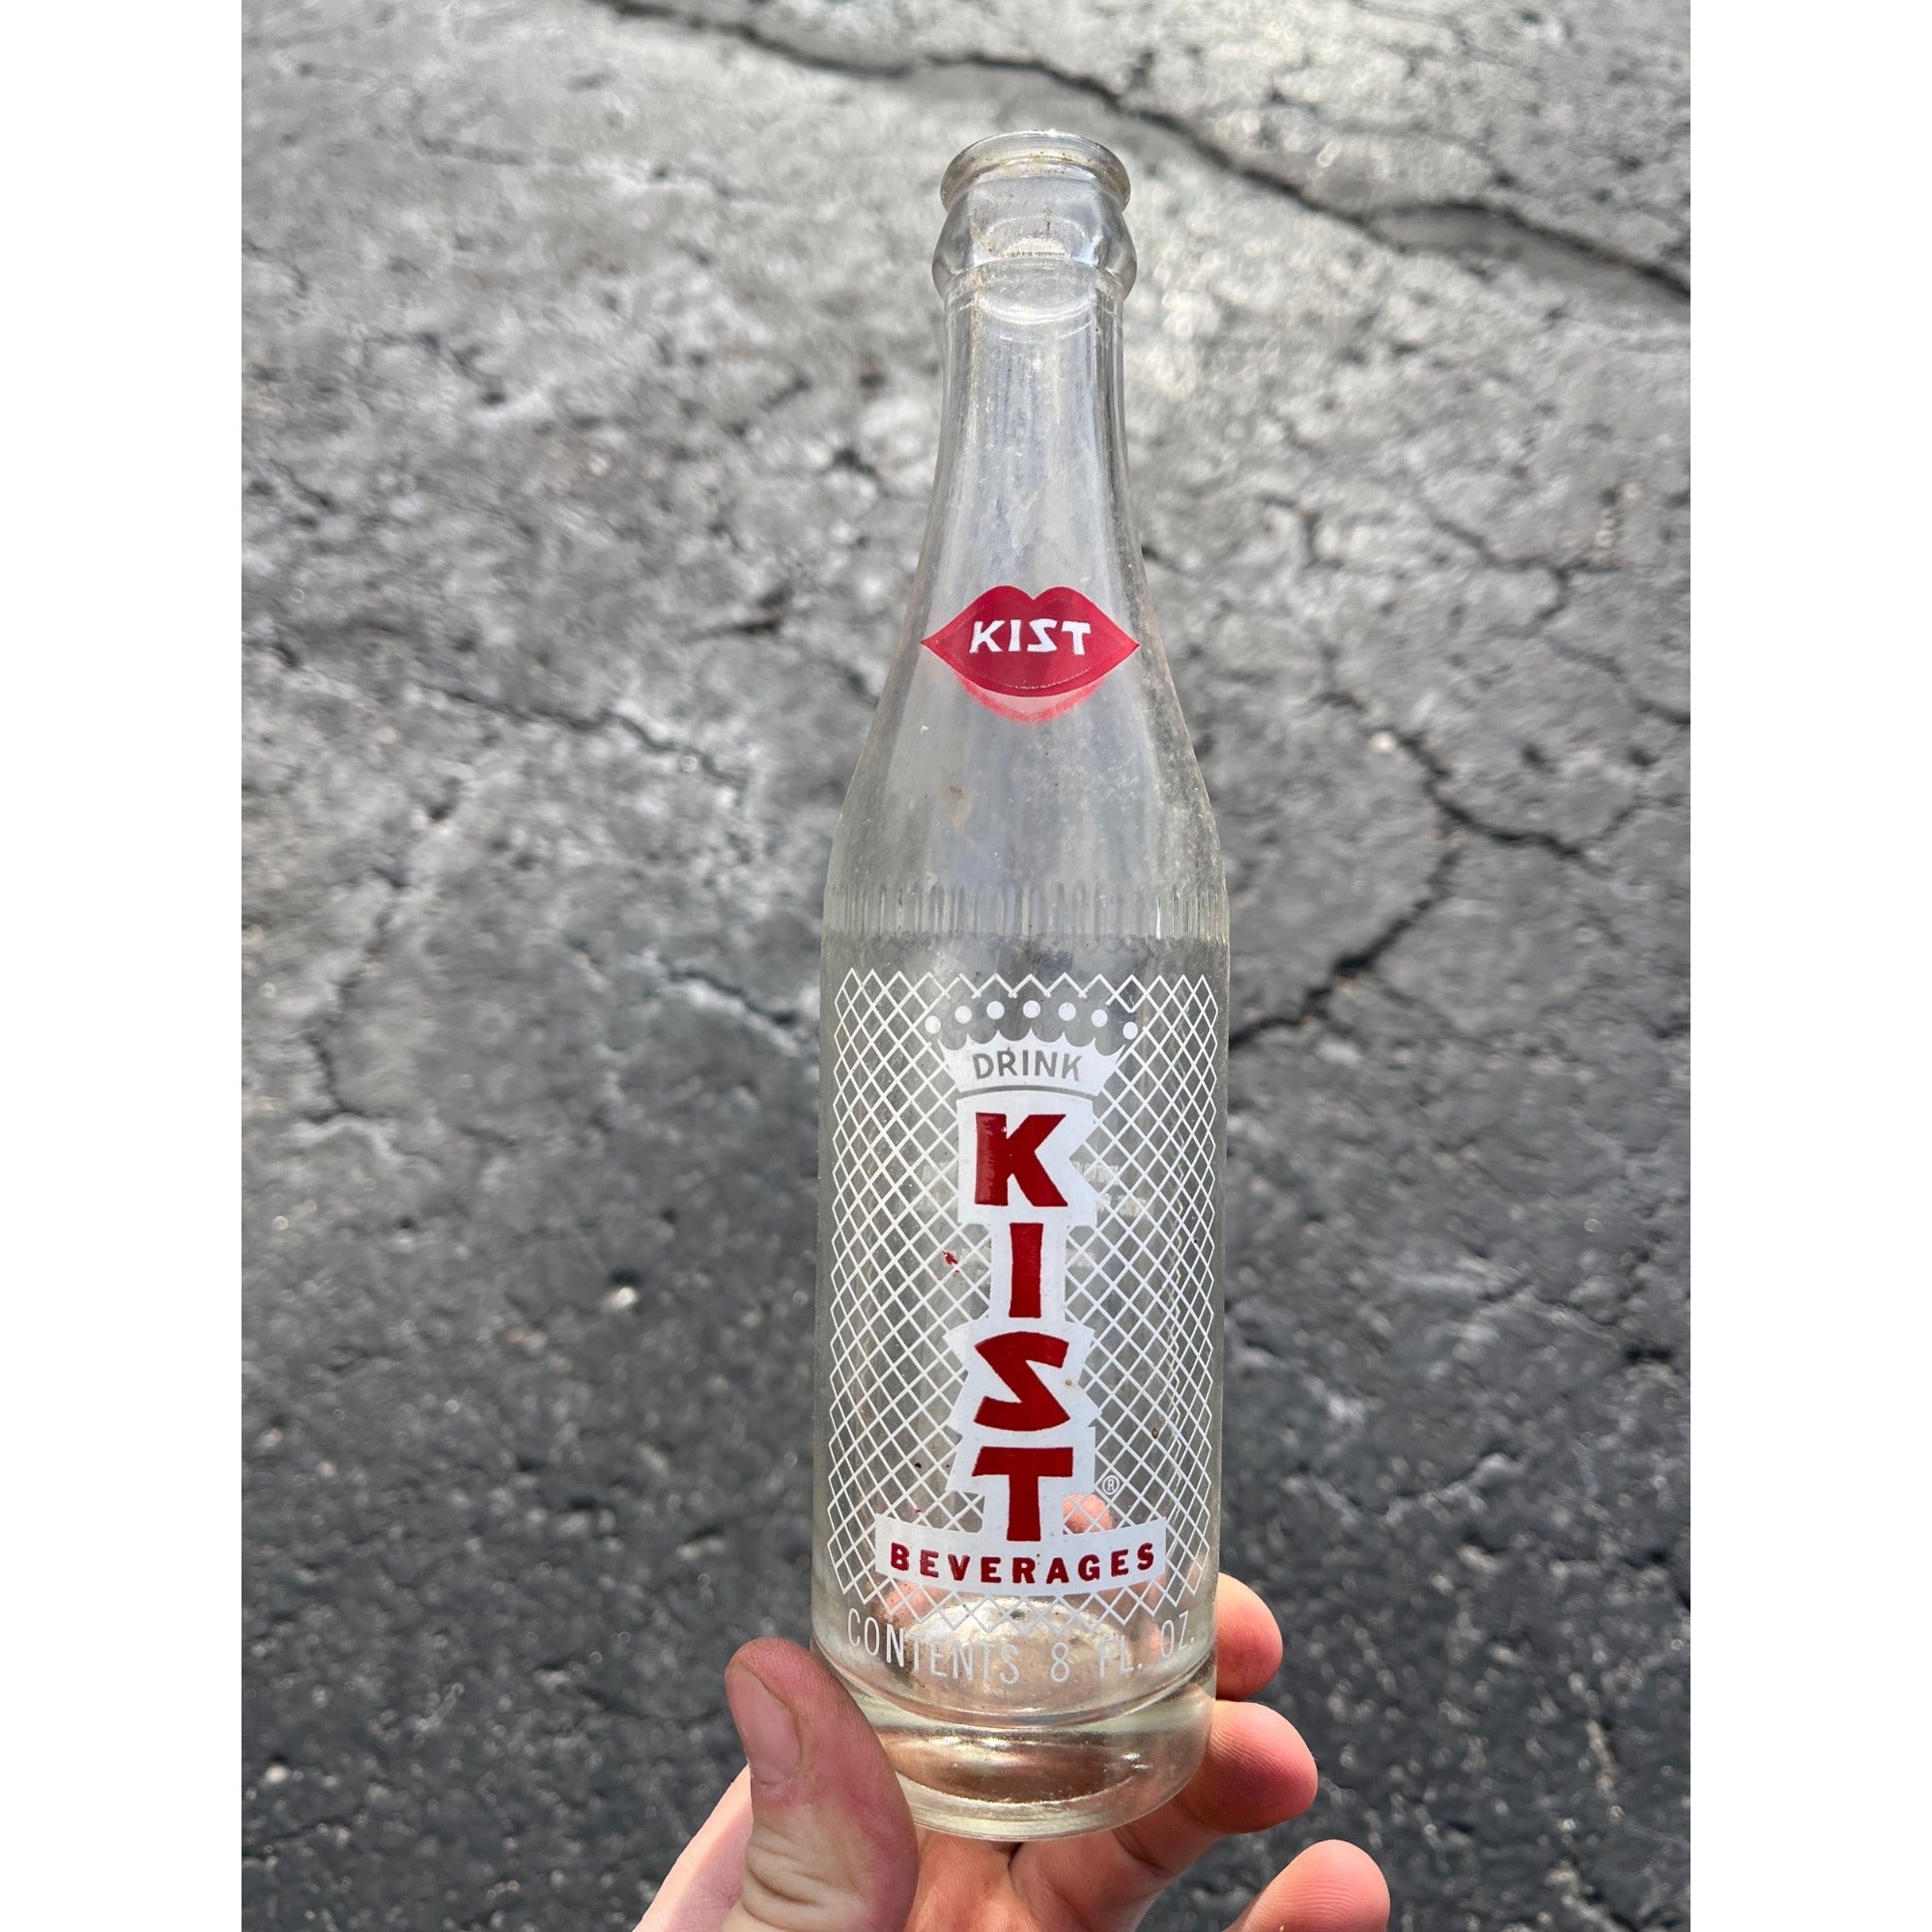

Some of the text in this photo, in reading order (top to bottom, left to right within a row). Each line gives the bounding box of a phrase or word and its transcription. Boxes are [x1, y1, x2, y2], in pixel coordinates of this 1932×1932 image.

[969, 618, 1092, 656] KIST
[972, 1049, 1083, 1082] DRINK
[972, 1112, 1074, 1543] KIST
[890, 1542, 1154, 1585] BEVERAGES
[846, 1607, 1196, 1686] CONTENTS 8 FL. OZ.
